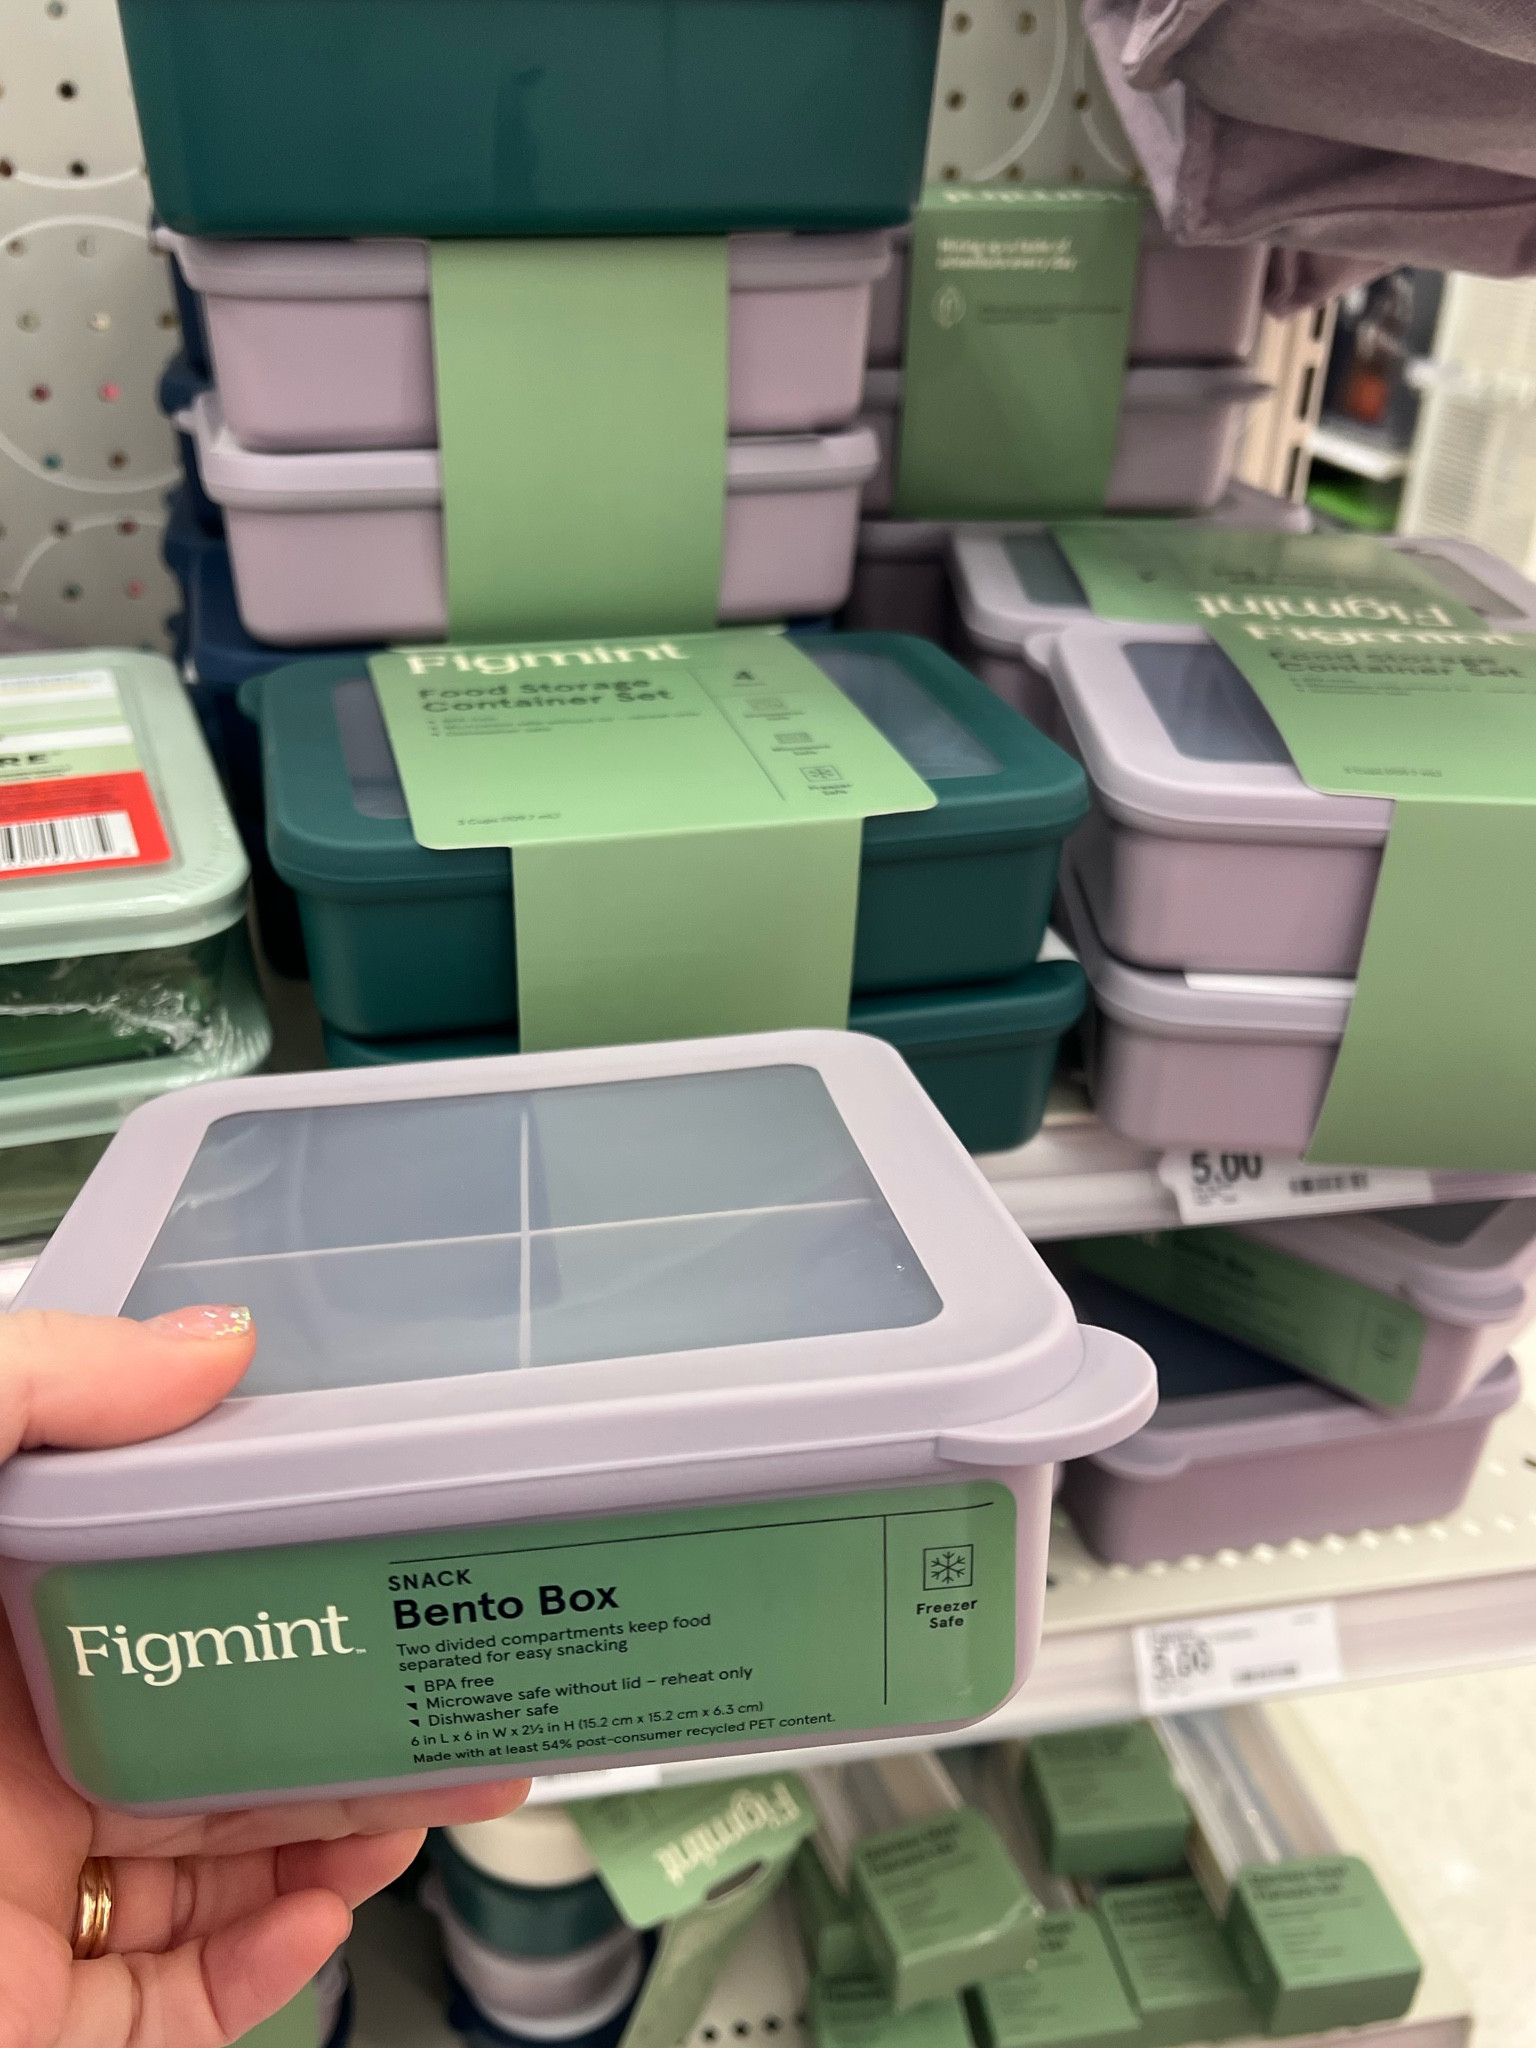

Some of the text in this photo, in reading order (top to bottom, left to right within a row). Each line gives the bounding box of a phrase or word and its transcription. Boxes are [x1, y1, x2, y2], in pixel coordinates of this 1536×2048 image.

[405, 643, 690, 675] Figmint
[419, 679, 651, 699] Food Storage
[423, 690, 673, 712] Container Set
[1191, 1152, 1263, 1185] 5.00
[388, 1569, 472, 1592] SNACK
[394, 1585, 620, 1630] Bento Box
[916, 1600, 978, 1615] Freezer
[929, 1615, 964, 1629] Safe
[396, 1613, 711, 1657] Two divided compartments keep food
[398, 1639, 628, 1672] separated for easy snacking
[424, 1677, 495, 1692] BPA free
[426, 1692, 513, 1709] Microwave
[518, 1687, 551, 1701] safe
[555, 1679, 617, 1697] without
[622, 1676, 641, 1690] lid
[661, 1670, 715, 1686] reheat
[718, 1666, 753, 1681] only
[411, 1736, 420, 1747] 6
[424, 1734, 437, 1745] in
[440, 1733, 449, 1744] L
[453, 1734, 460, 1742] x
[464, 1731, 473, 1741] 6
[476, 1729, 489, 1740] in
[492, 1727, 507, 1738] W
[547, 1722, 560, 1733] in
[564, 1720, 574, 1731] H
[578, 1717, 608, 1730] (15.2
[612, 1716, 633, 1726] cm
[637, 1716, 644, 1724] x
[648, 1710, 673, 1723] 15.2
[677, 1709, 698, 1720] cm
[702, 1709, 709, 1717] x
[713, 1704, 734, 1716] 6.3
[738, 1701, 764, 1713] cm)
[429, 1703, 560, 1727] Dishwasher safe
[413, 1712, 836, 1764] Made with at least 54% post-consumer recycled PET content.
